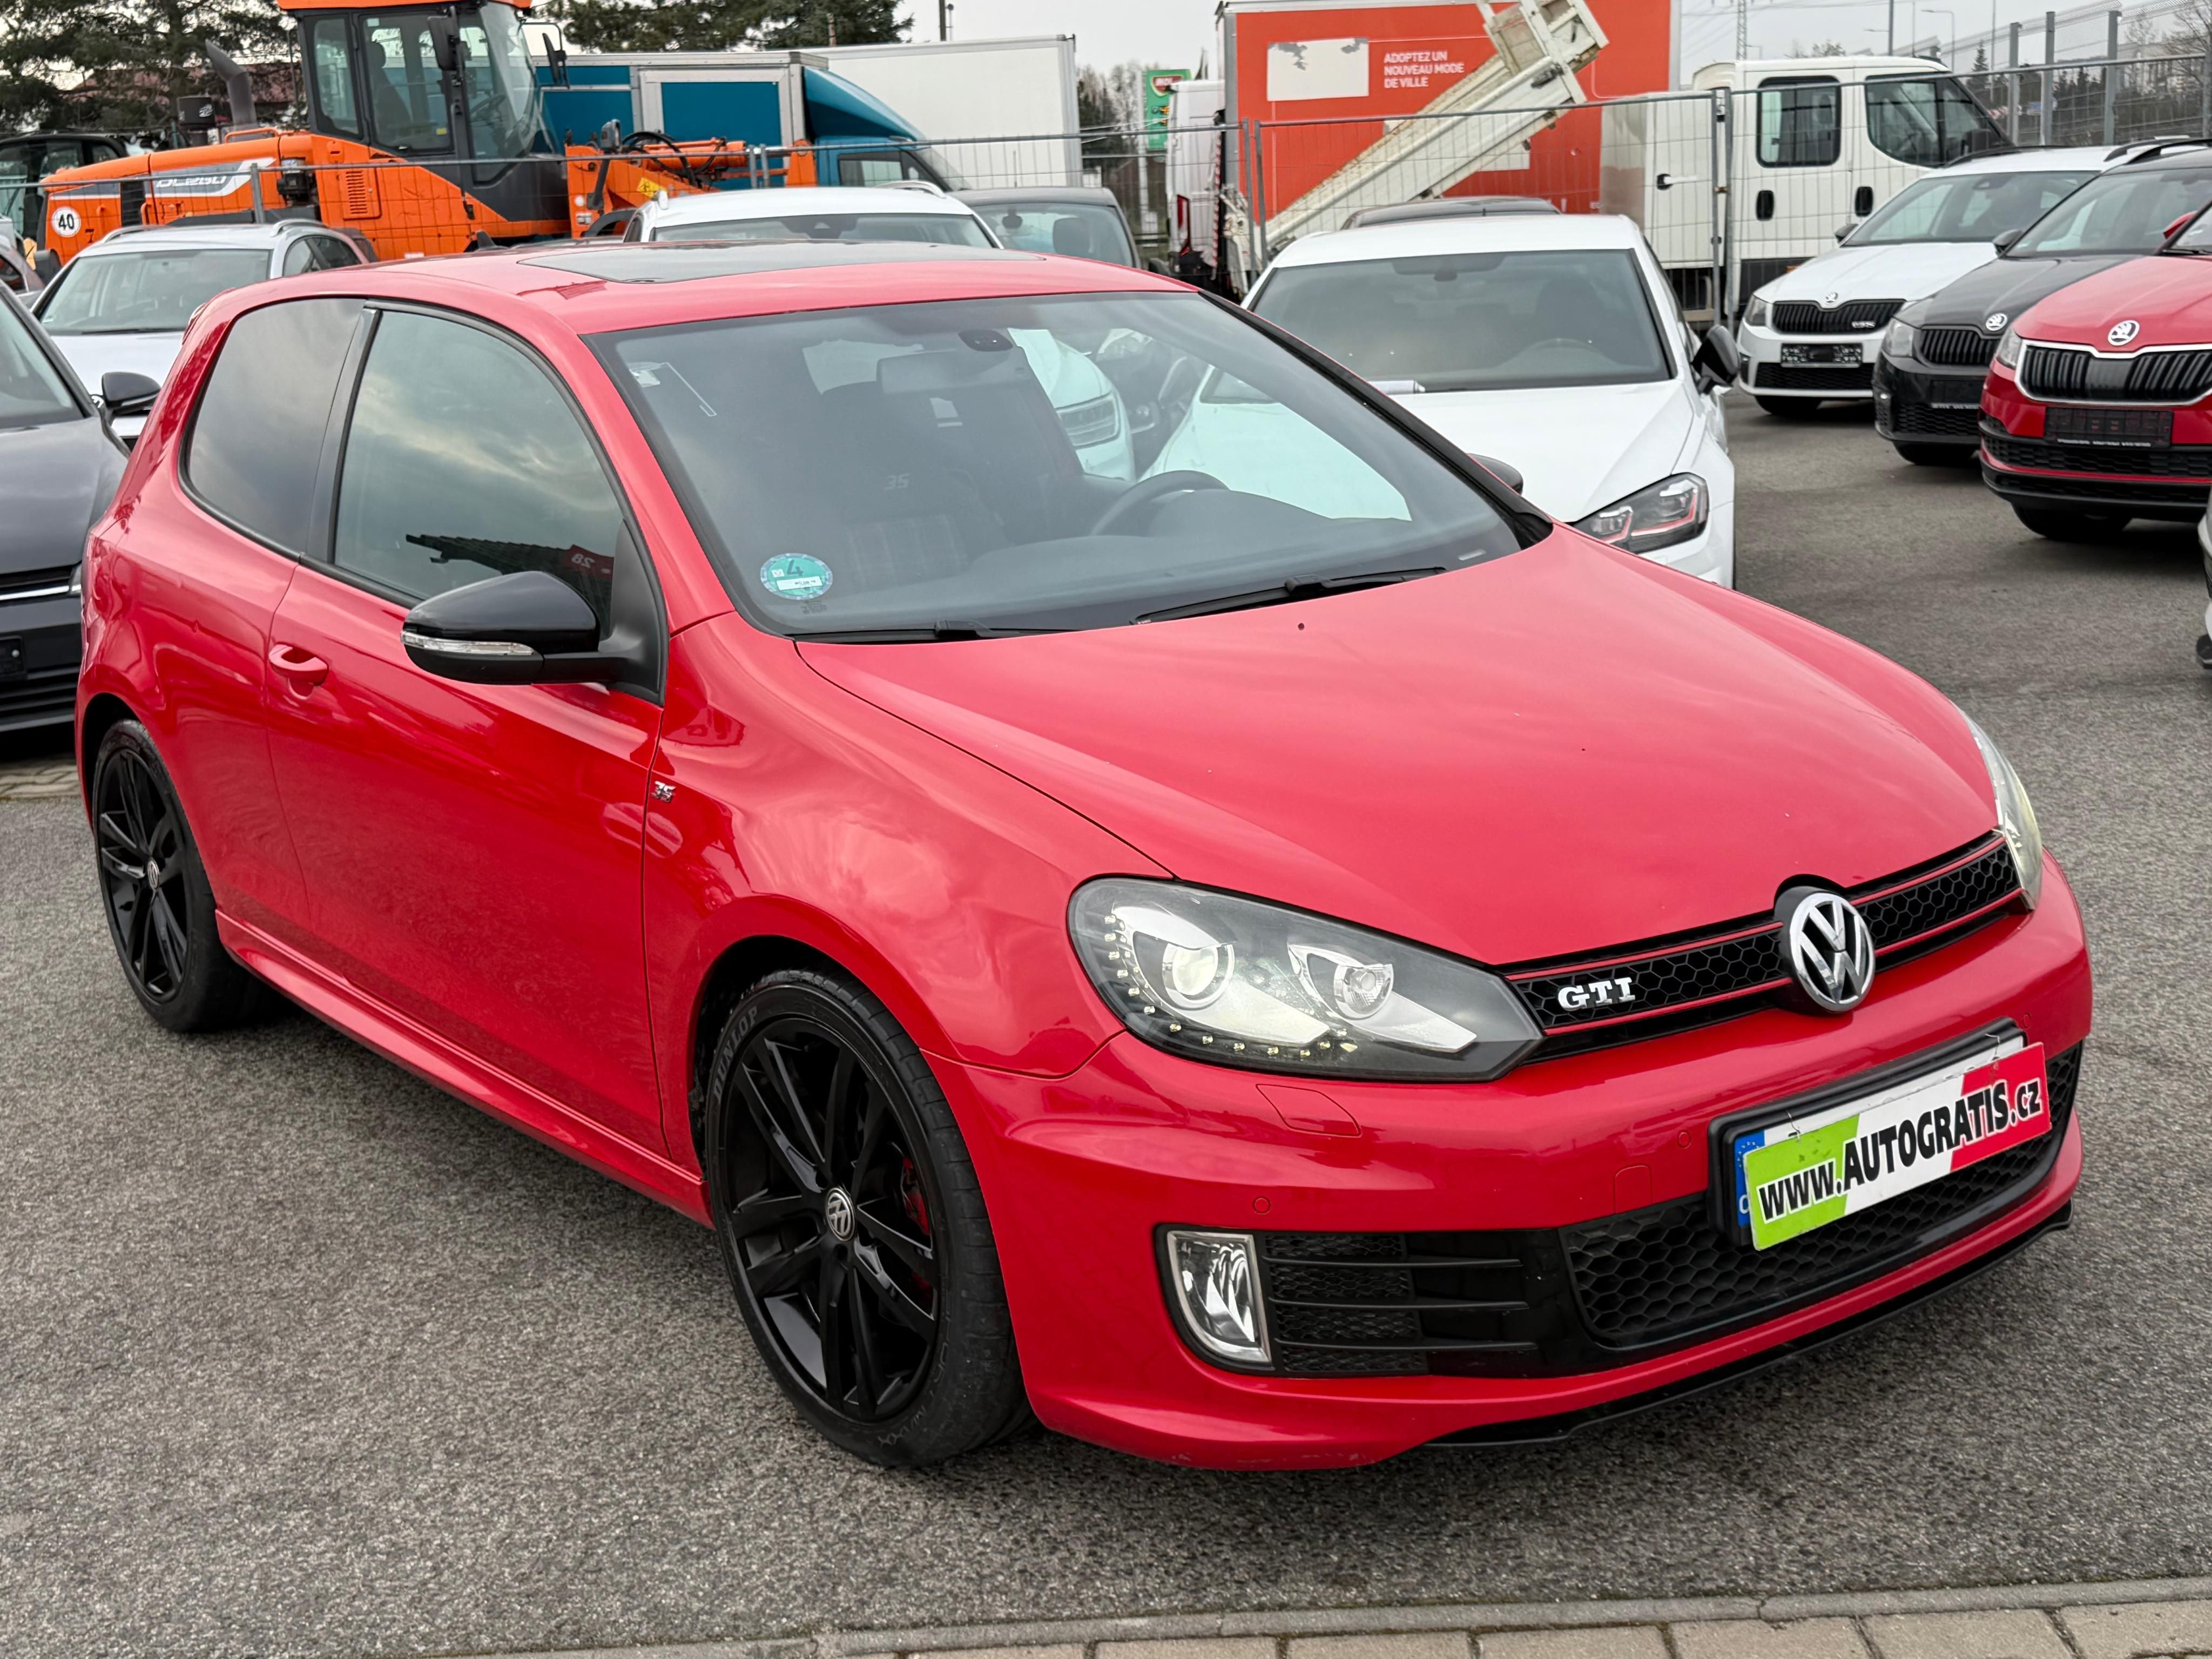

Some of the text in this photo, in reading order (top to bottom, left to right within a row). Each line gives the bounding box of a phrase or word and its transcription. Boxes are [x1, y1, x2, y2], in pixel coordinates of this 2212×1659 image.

[1384, 50, 1448, 63] ADOPTEZ UN
[1384, 62, 1465, 76] NOUVEAU MODE
[1384, 76, 1429, 88] DE VILLE
[58, 214, 75, 230] 40
[787, 559, 804, 576] 4
[1558, 976, 1636, 1011] GTI
[712, 1004, 758, 1105] DUNLOP
